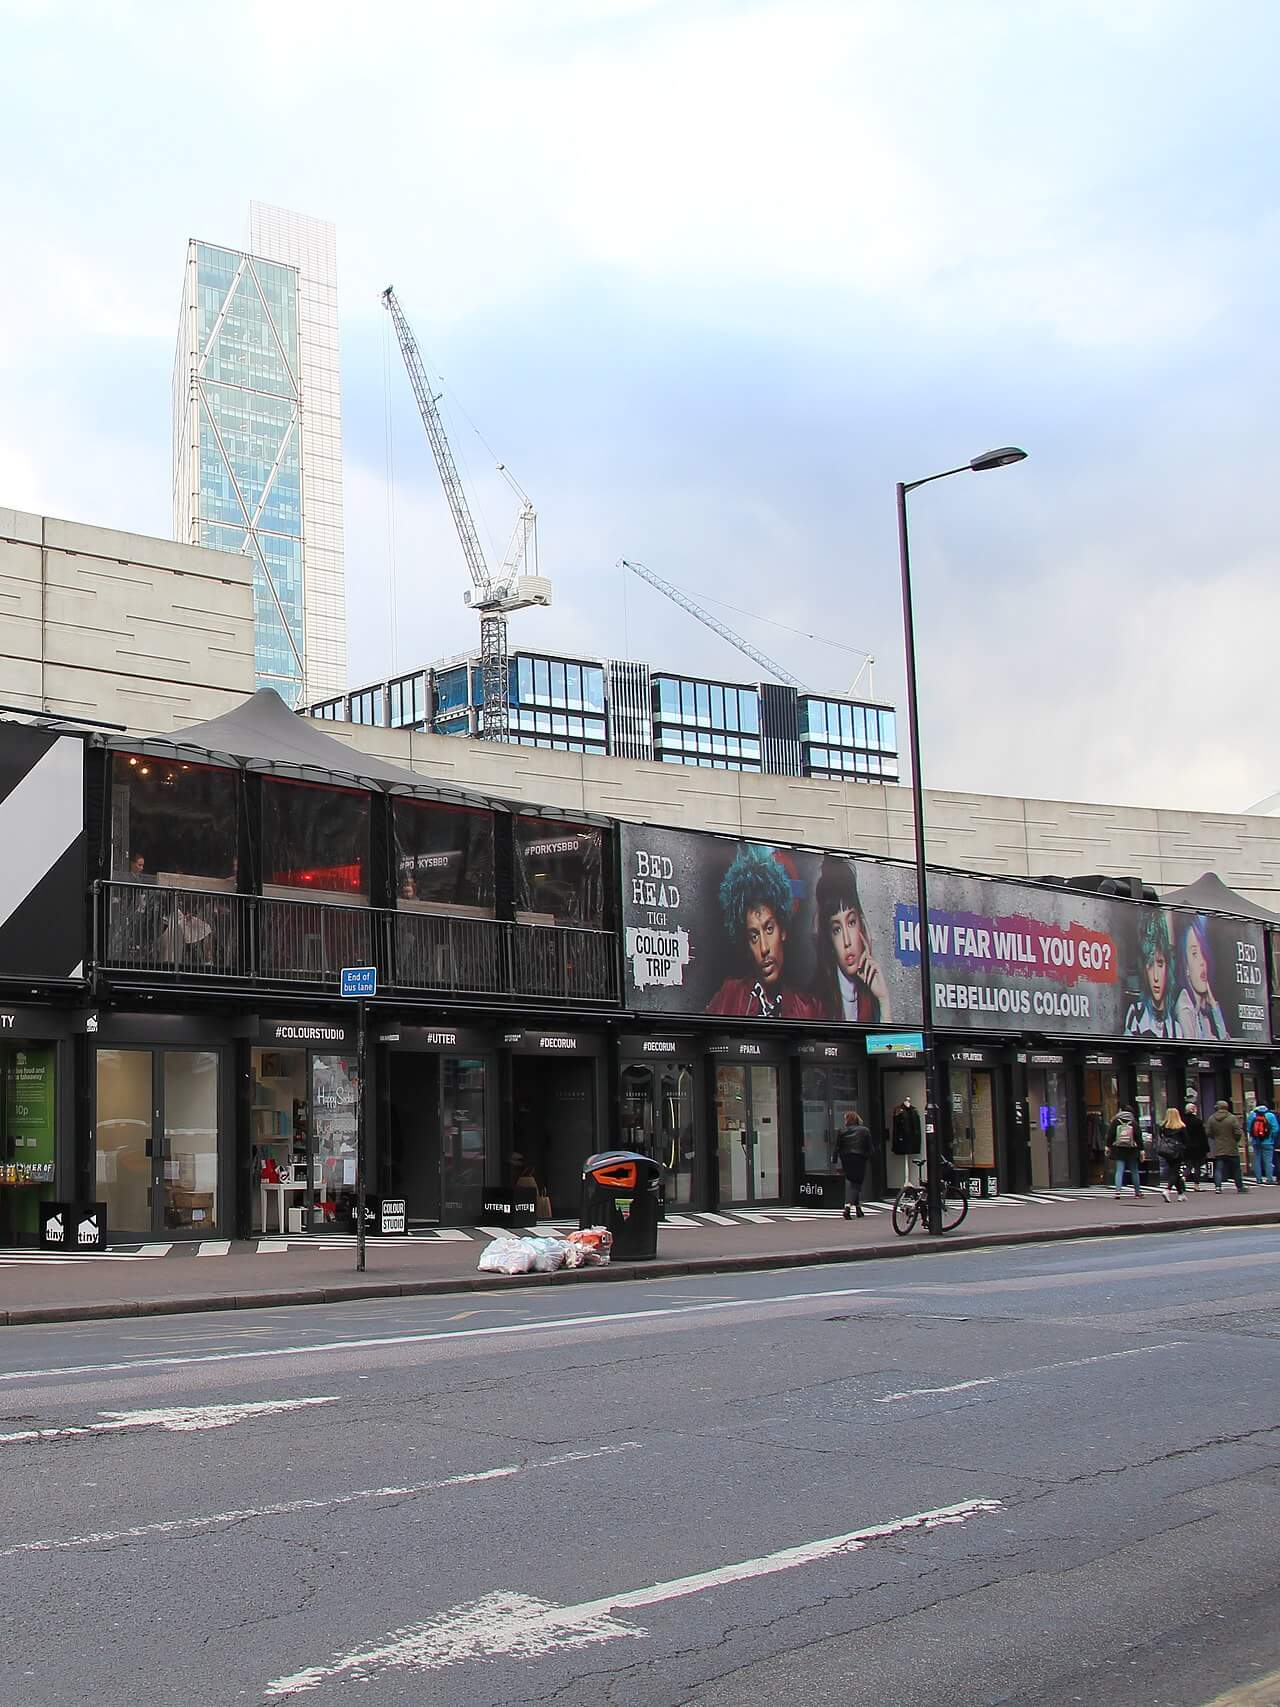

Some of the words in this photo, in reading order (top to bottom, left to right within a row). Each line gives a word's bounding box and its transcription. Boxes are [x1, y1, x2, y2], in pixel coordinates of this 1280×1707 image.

[636, 850, 673, 879] BED
[632, 879, 680, 908] HEAD
[647, 911, 667, 926] TIGI
[636, 935, 680, 957] COLOUR
[953, 926, 992, 959] FAR
[992, 931, 1037, 963] WILL
[1038, 936, 1074, 967] YOU
[1078, 940, 1112, 971] GO?
[1236, 941, 1257, 962] BED
[646, 958, 671, 977] TRIP
[1235, 963, 1262, 985] HEAD
[348, 972, 361, 981] End
[362, 972, 371, 981] of
[344, 983, 357, 992] bus
[358, 983, 373, 991] lane
[935, 983, 1030, 1014] REBELLIOUS
[1033, 991, 1090, 1018] COLOUR
[275, 1026, 345, 1040] #COLOURSTUDIO
[427, 1033, 456, 1045] #UTTER
[539, 1037, 577, 1049] #DECORUM
[643, 1041, 676, 1052] #DECORUM
[383, 1203, 404, 1214] COLOUR
[484, 1203, 503, 1211] UTTER
[515, 1203, 530, 1211] UTTER
[383, 1218, 404, 1230] STUDIO
[46, 1228, 64, 1242] tiny
[78, 1232, 98, 1245] tiny
